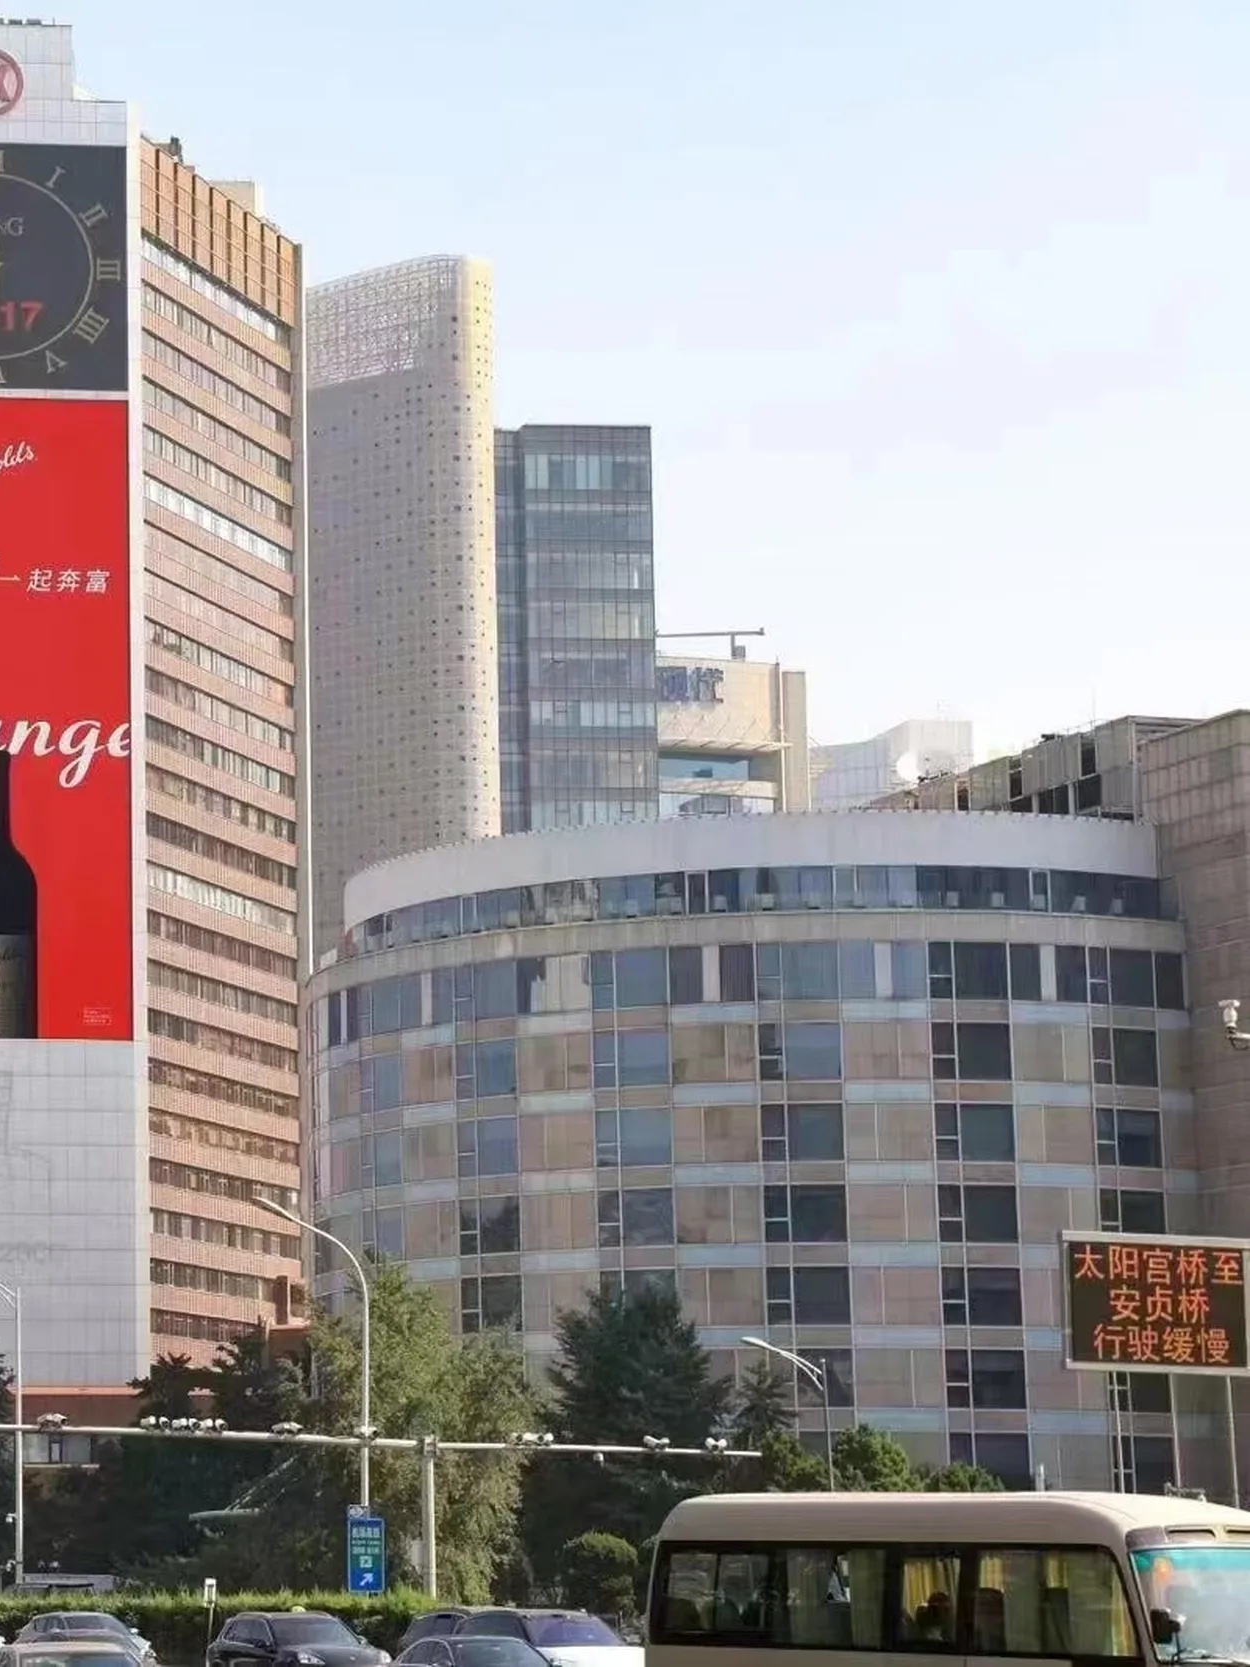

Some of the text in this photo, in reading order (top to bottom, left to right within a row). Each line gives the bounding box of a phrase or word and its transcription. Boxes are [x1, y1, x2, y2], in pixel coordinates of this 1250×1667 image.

[79, 203, 109, 228] II
[97, 258, 121, 281] III
[45, 350, 68, 374] V
[1074, 1244, 1243, 1285] 太阳宫桥至
[1109, 1285, 1210, 1324] 安贞桥
[1093, 1324, 1230, 1363] 行驶缓慢
